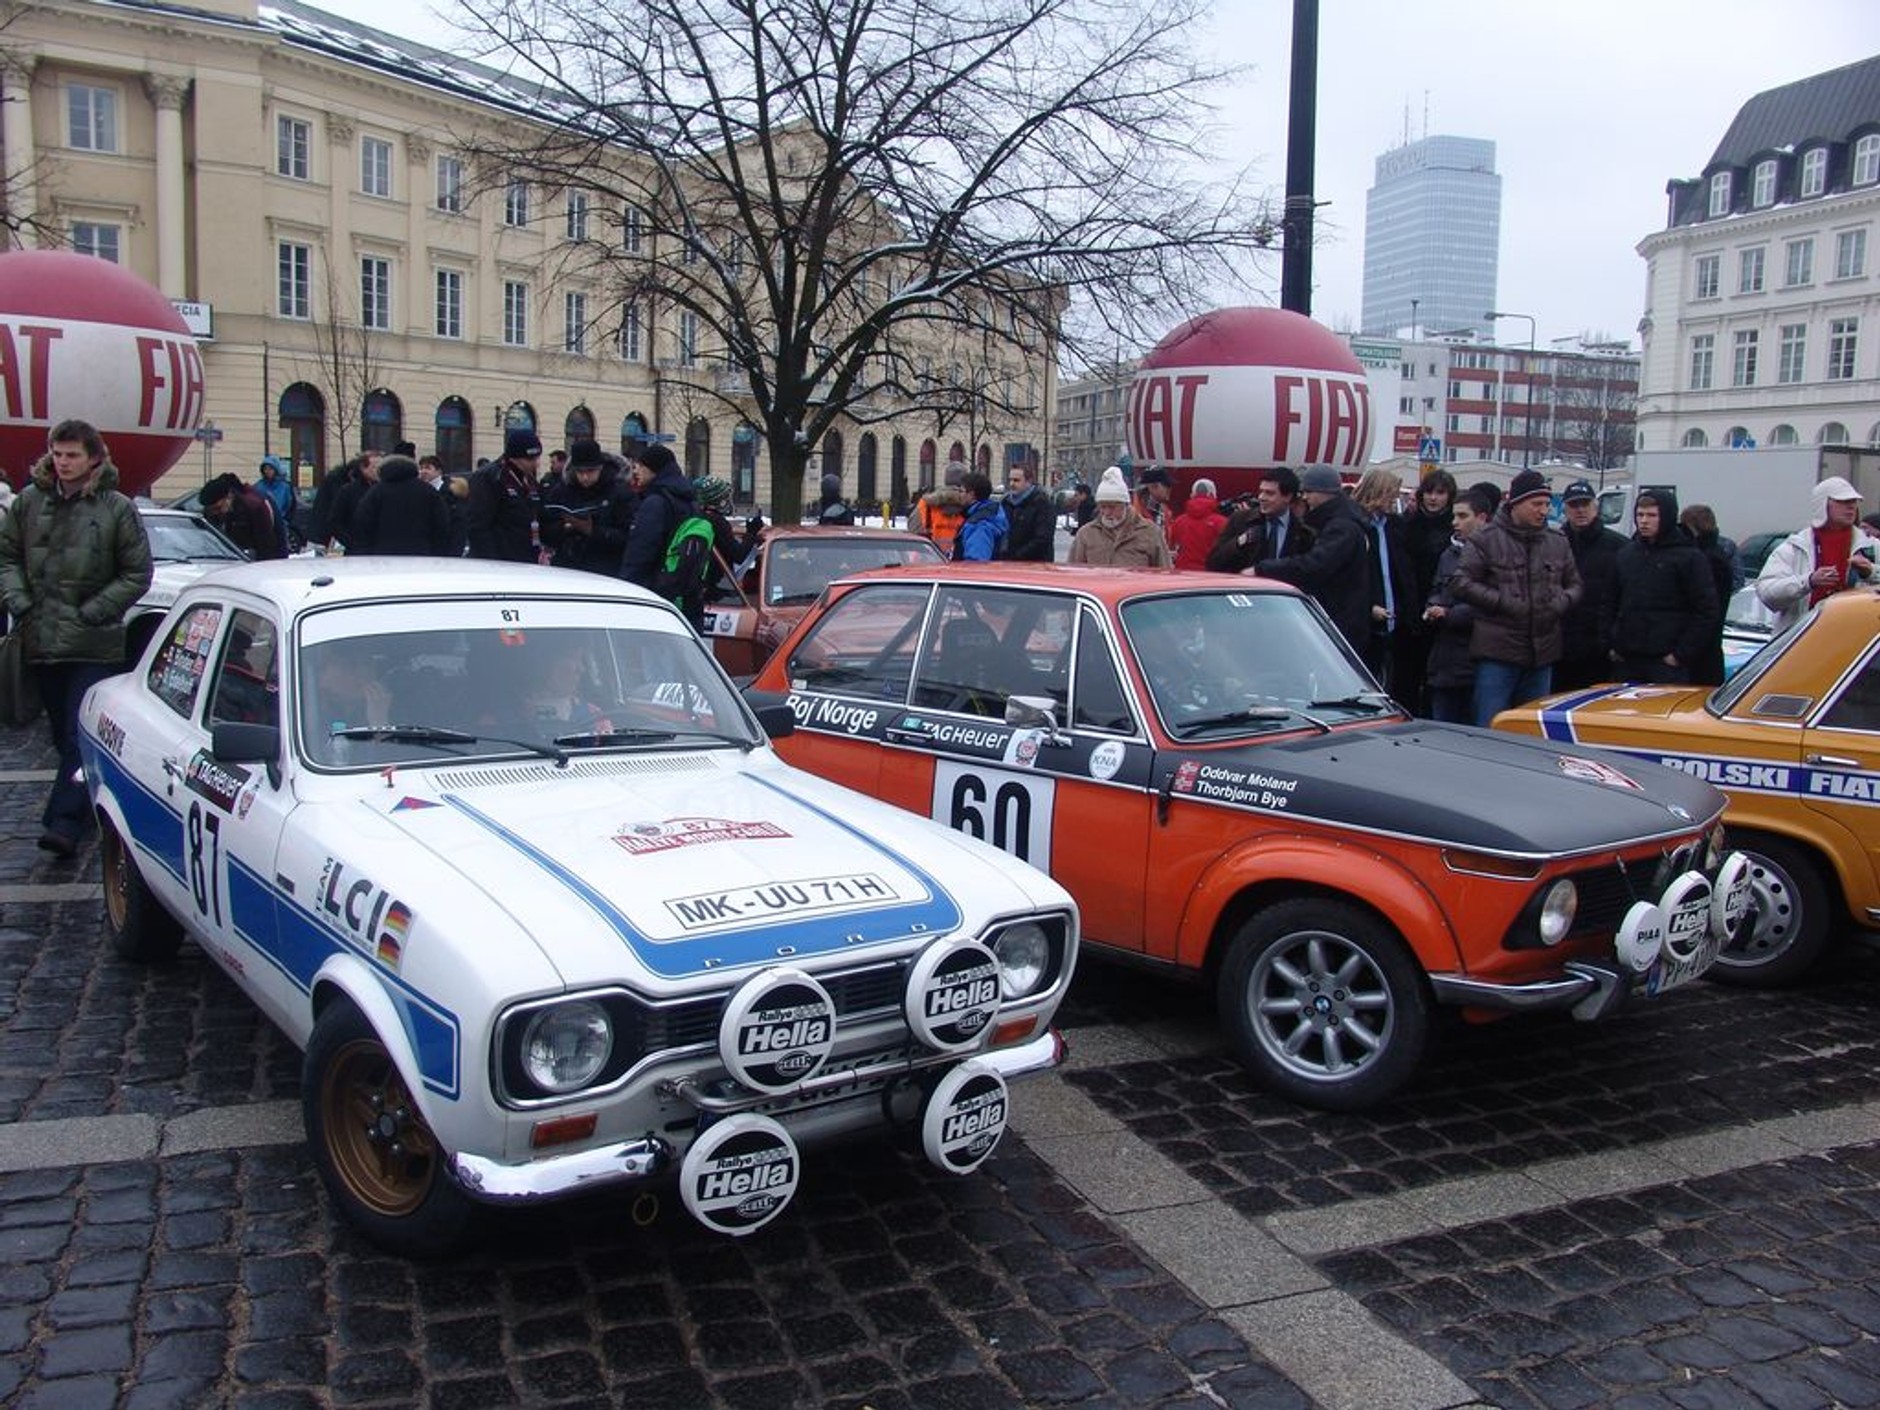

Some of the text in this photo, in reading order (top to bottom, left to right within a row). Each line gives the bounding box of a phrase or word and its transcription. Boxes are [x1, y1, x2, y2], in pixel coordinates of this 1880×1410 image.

[501, 610, 519, 621] 87
[816, 699, 877, 733] Norge
[1200, 765, 1297, 792] Oddvar Moland
[1261, 791, 1287, 808] Bye
[951, 774, 1031, 862] 60
[189, 800, 222, 928] 87
[316, 857, 333, 911] TEAM
[325, 862, 389, 943] LCI
[930, 981, 995, 1014] Hella
[743, 1020, 826, 1053] Hella
[945, 1104, 1002, 1140] Hella
[703, 1164, 789, 1198] Hella
